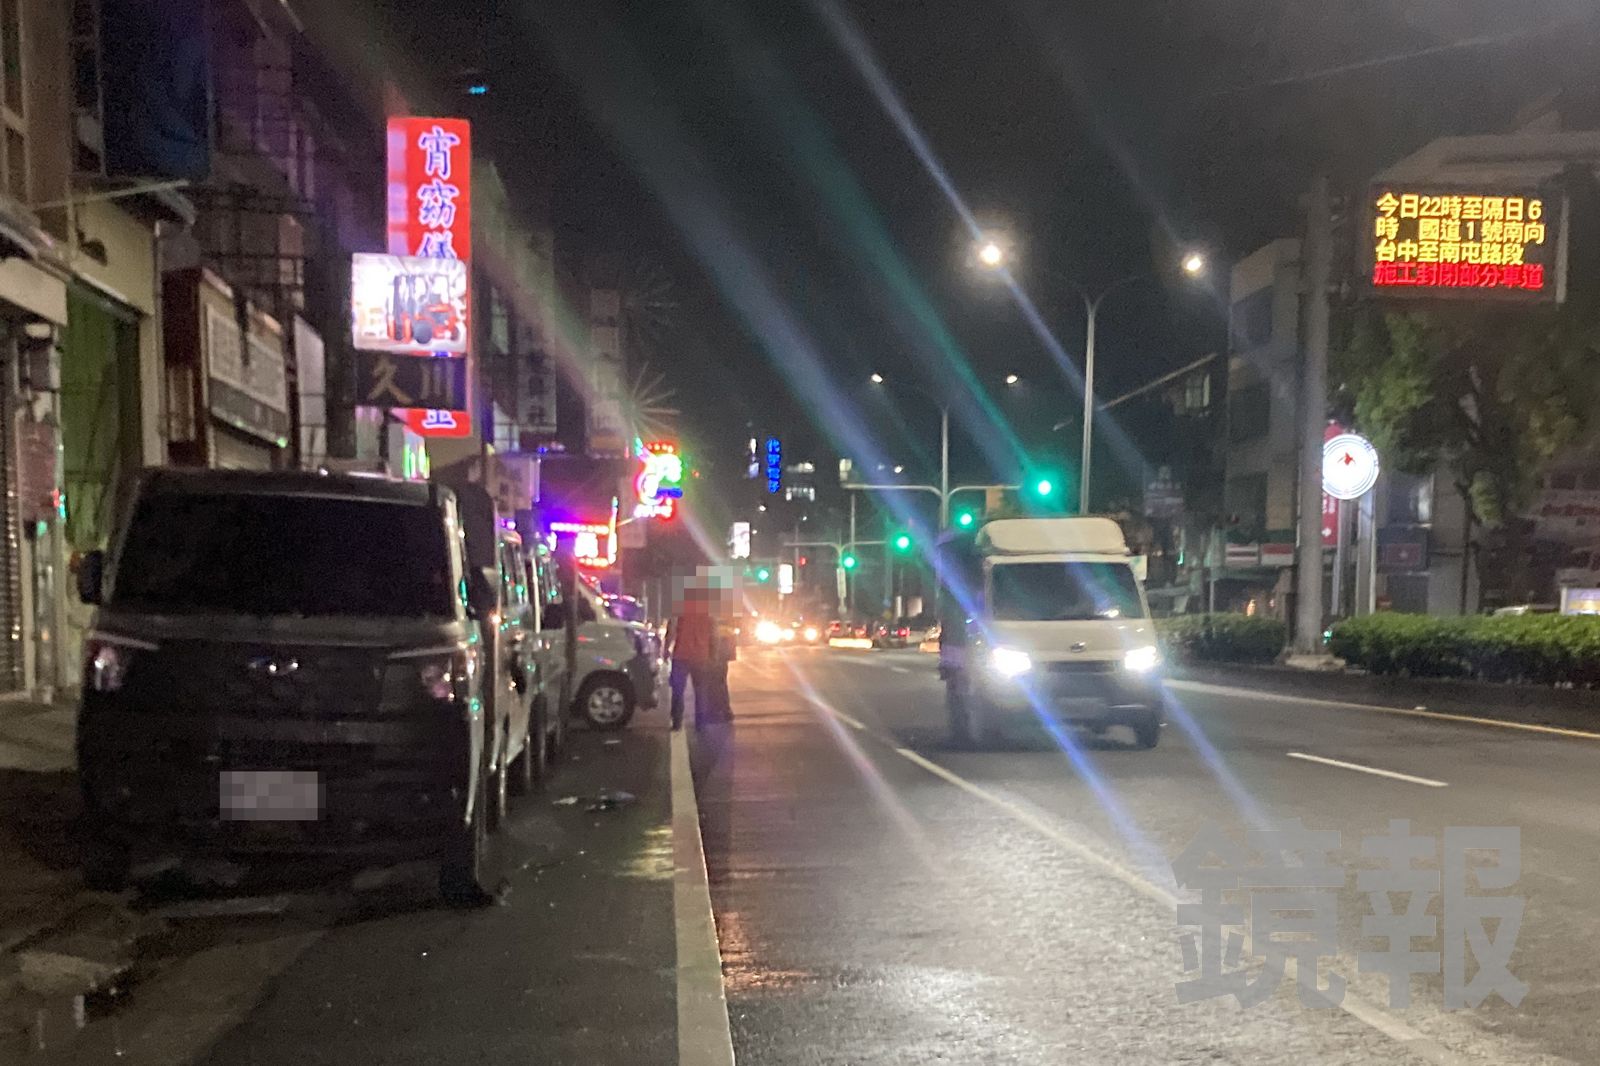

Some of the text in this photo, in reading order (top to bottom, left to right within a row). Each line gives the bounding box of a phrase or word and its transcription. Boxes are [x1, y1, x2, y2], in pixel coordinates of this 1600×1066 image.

[1375, 217, 1399, 240] 時
[1376, 240, 1524, 265] 台中至南屯路段
[1374, 262, 1544, 288] 施工封閉部分車道
